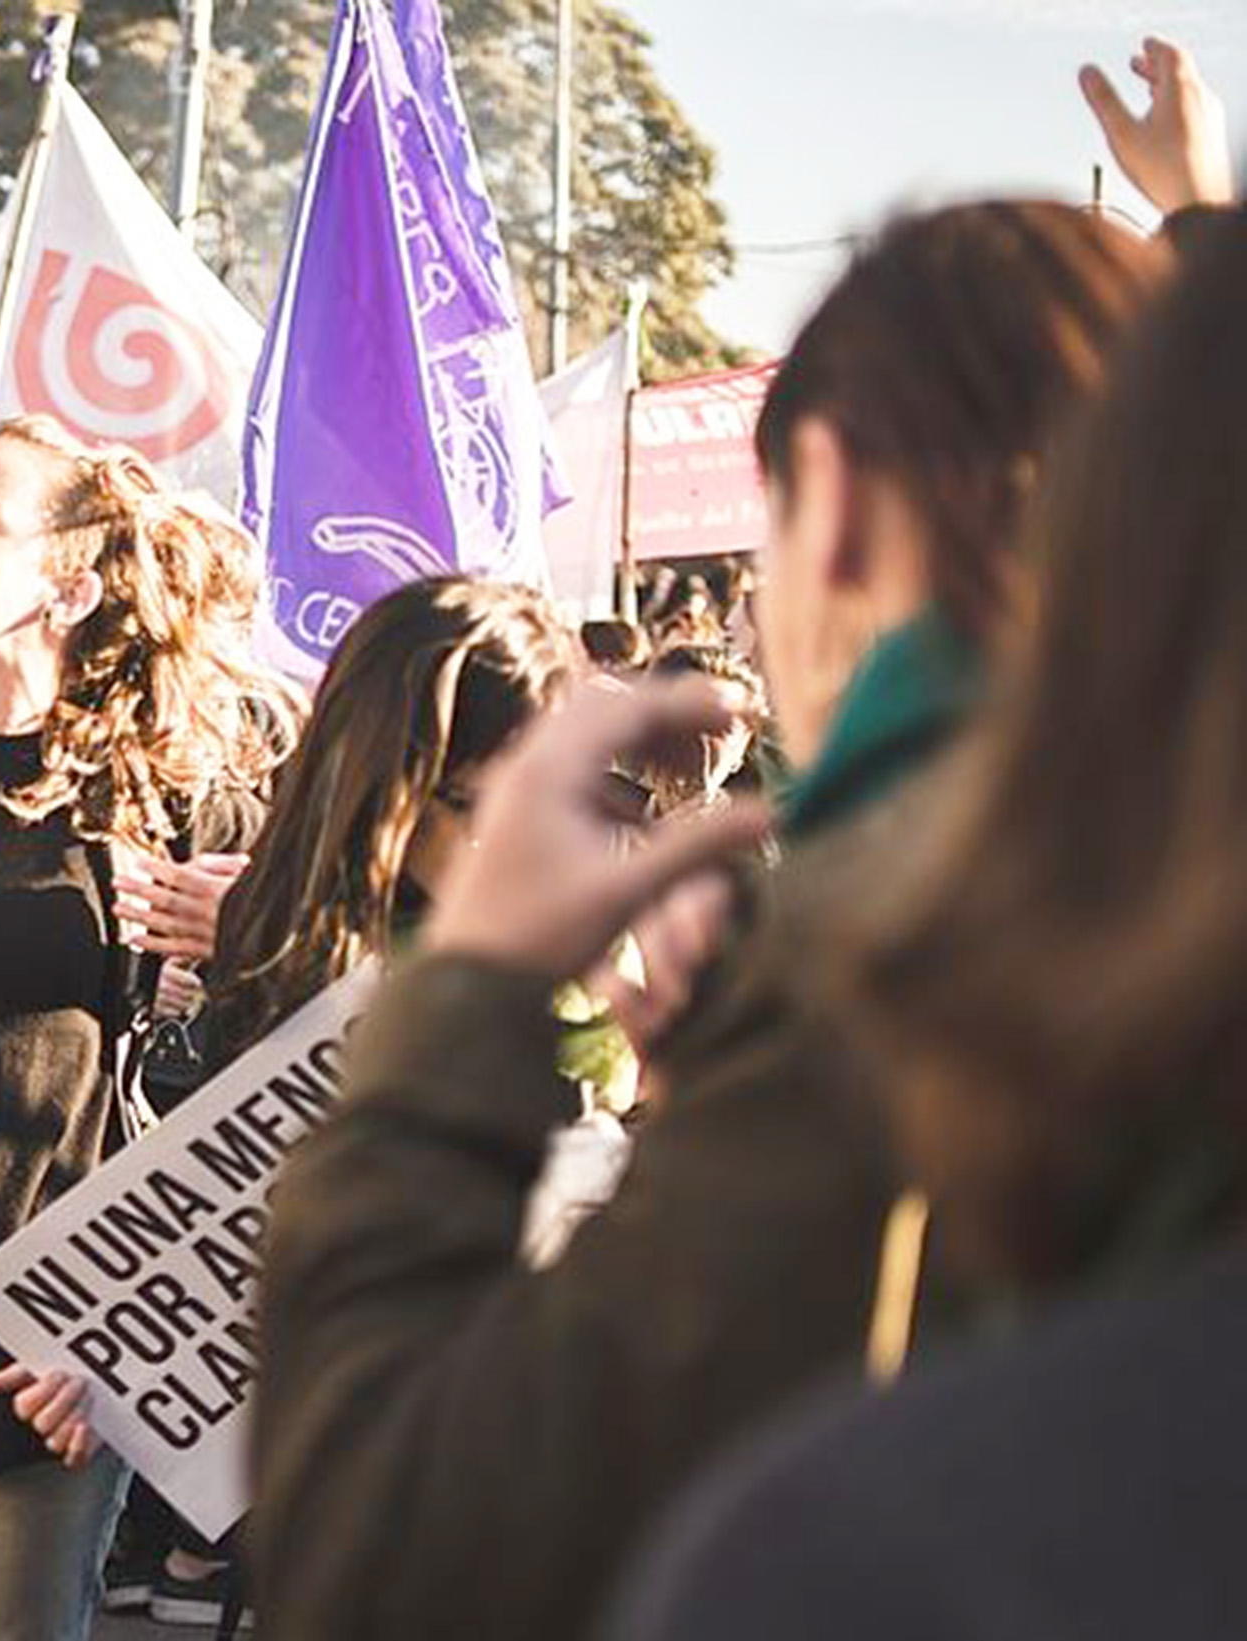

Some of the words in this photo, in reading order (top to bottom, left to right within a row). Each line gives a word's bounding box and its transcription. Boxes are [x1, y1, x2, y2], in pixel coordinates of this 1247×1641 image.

[2, 1255, 99, 1337] NI
[67, 1169, 218, 1283] UNA
[185, 1013, 369, 1194] MENO
[66, 1272, 217, 1396] POR
